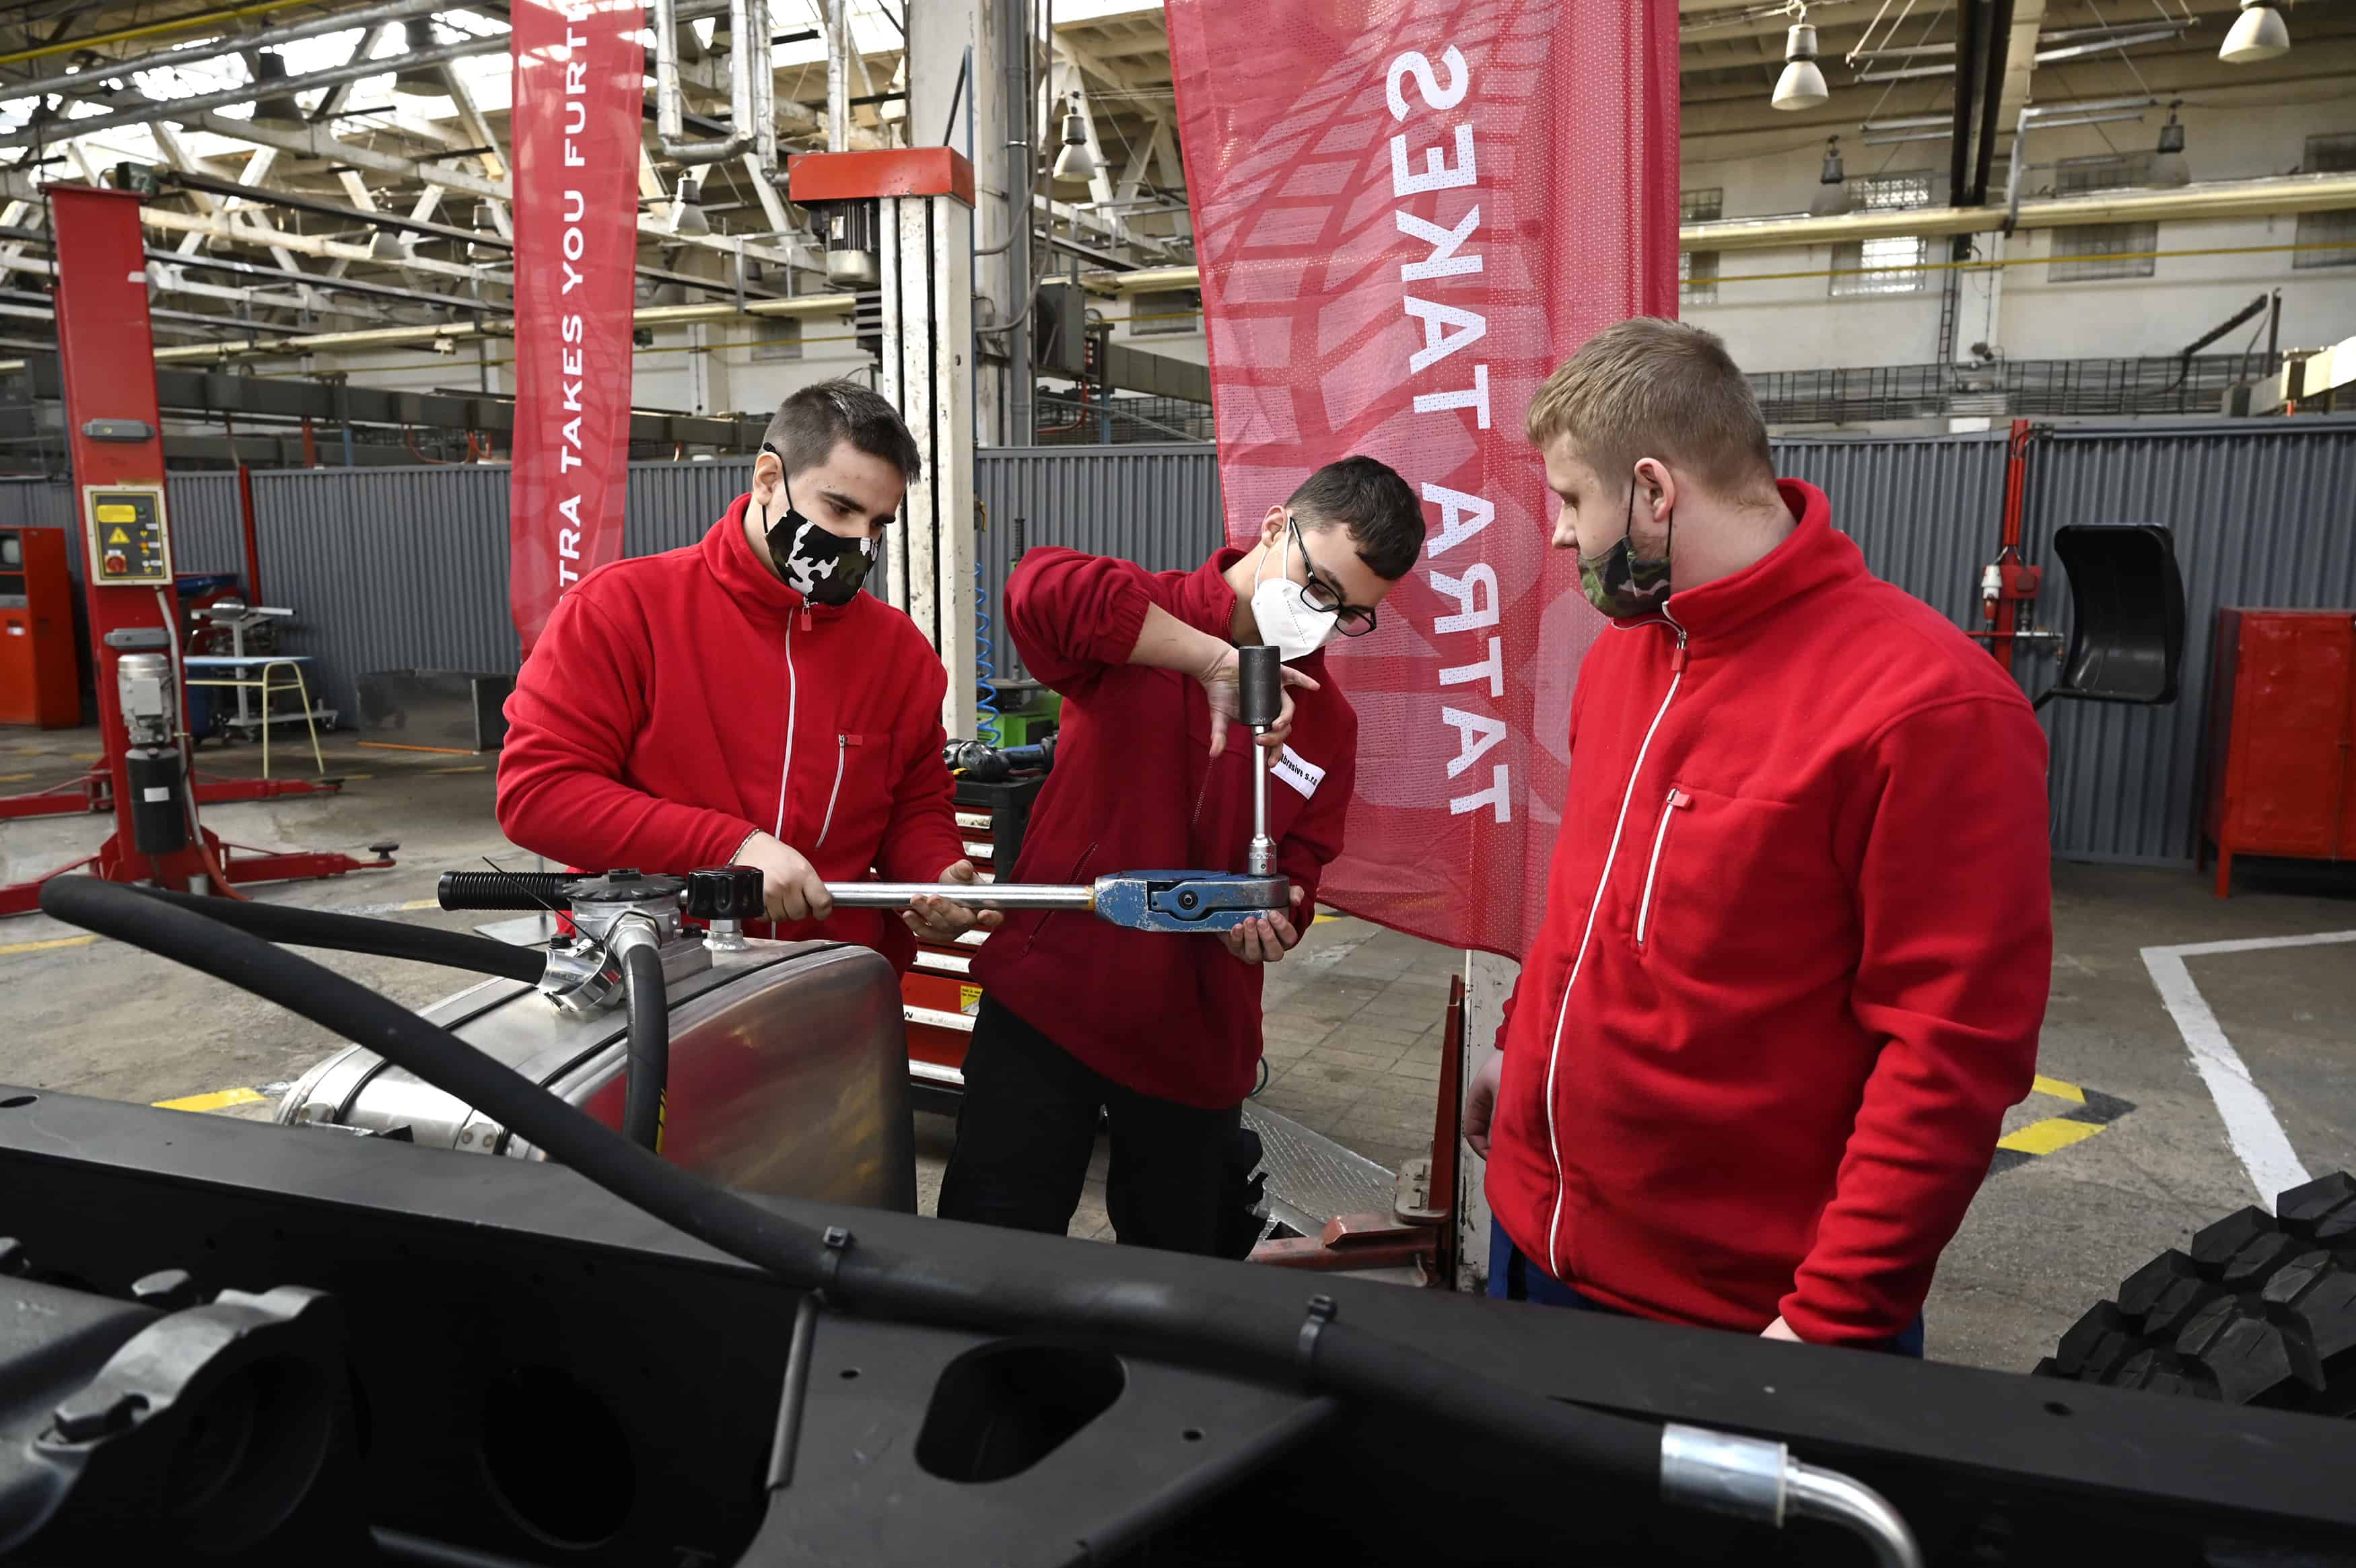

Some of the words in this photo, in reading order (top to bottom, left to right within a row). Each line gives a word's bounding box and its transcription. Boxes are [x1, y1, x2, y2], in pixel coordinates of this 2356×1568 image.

[561, 190, 584, 295] YOU
[561, 314, 583, 474] TAKES
[559, 495, 582, 603] TRA
